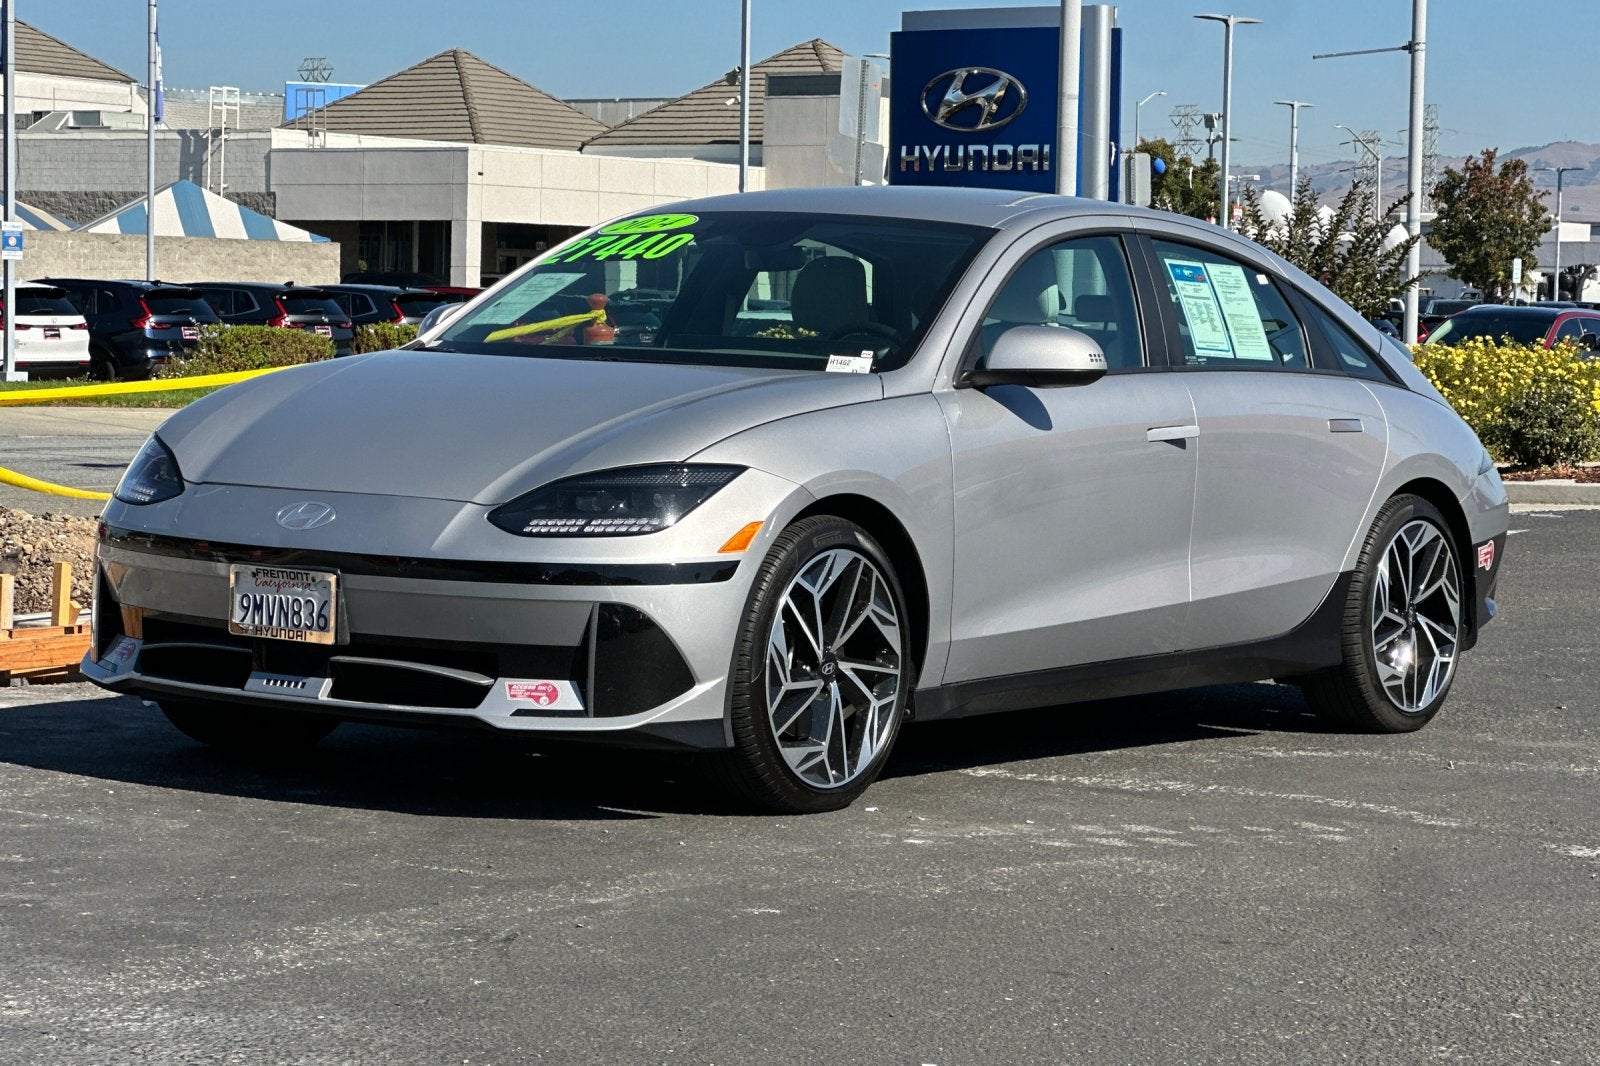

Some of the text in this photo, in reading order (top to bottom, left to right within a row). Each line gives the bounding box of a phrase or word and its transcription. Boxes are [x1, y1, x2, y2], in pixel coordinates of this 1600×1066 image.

[900, 143, 1050, 172] HYUNDAI
[537, 233, 695, 264] 27440
[254, 578, 317, 593] California
[255, 568, 310, 581] FREMONT
[240, 593, 328, 631] 9MVN836
[255, 625, 307, 641] HYUNDAI
